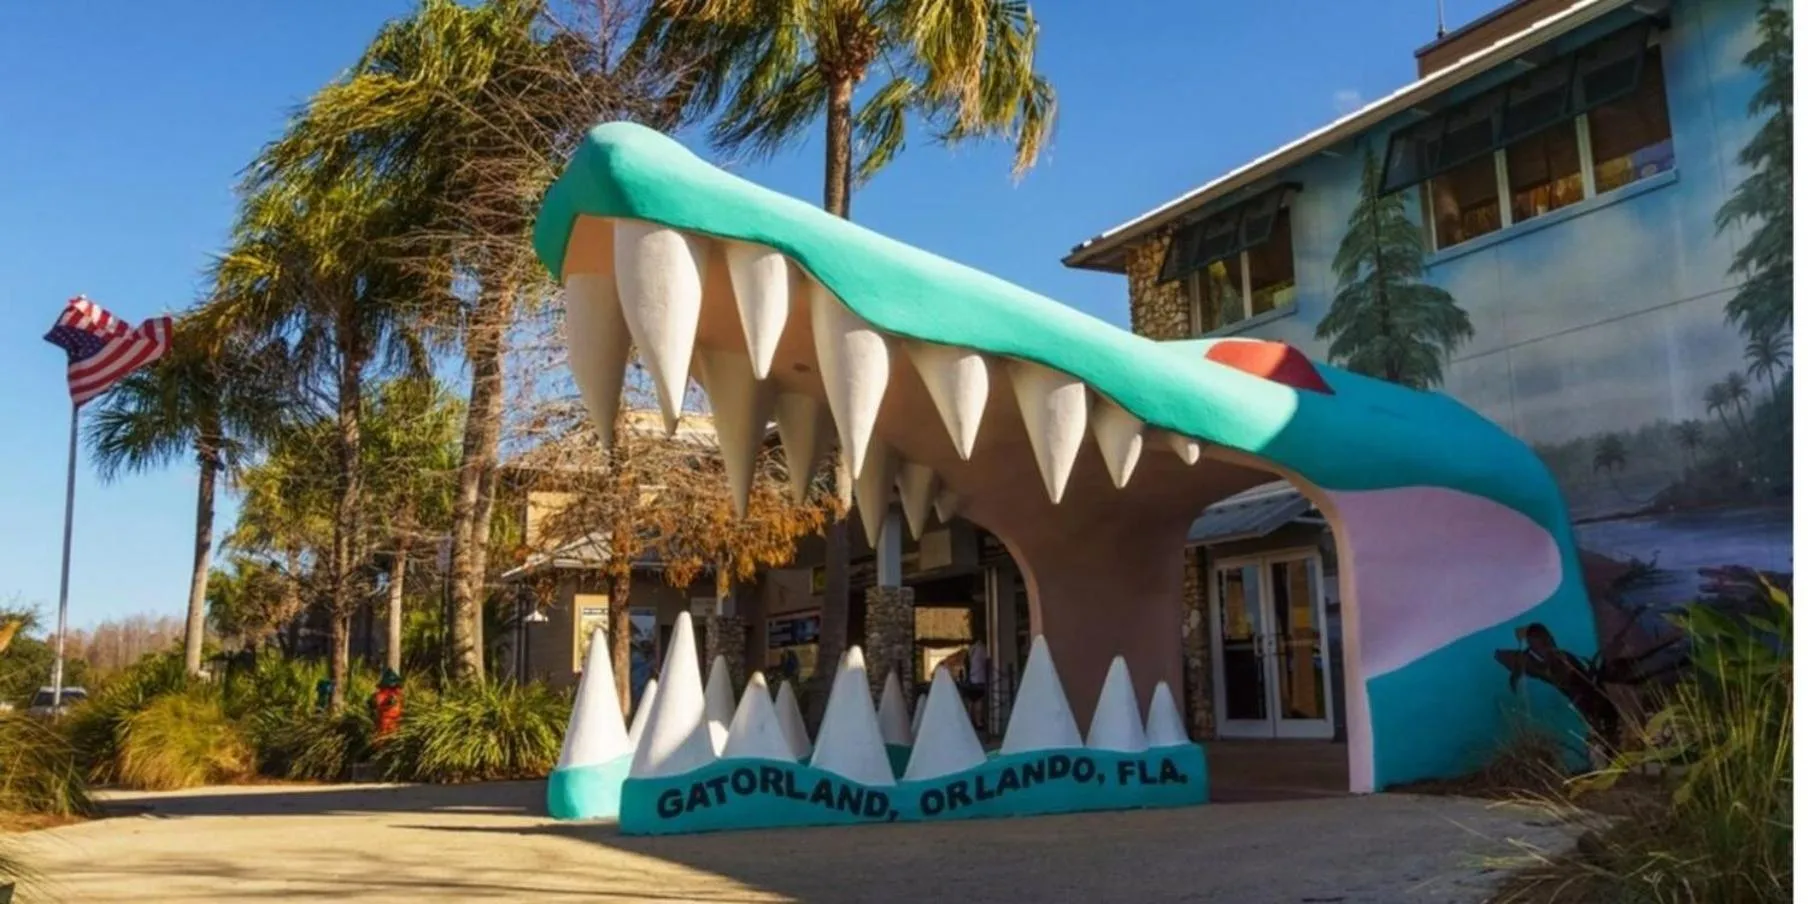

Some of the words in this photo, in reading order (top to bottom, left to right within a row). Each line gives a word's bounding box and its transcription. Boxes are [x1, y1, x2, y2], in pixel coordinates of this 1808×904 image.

[656, 766, 899, 822] GATORLAND,
[919, 754, 1105, 817] ORLANDO,
[1117, 758, 1189, 786] FLA.
